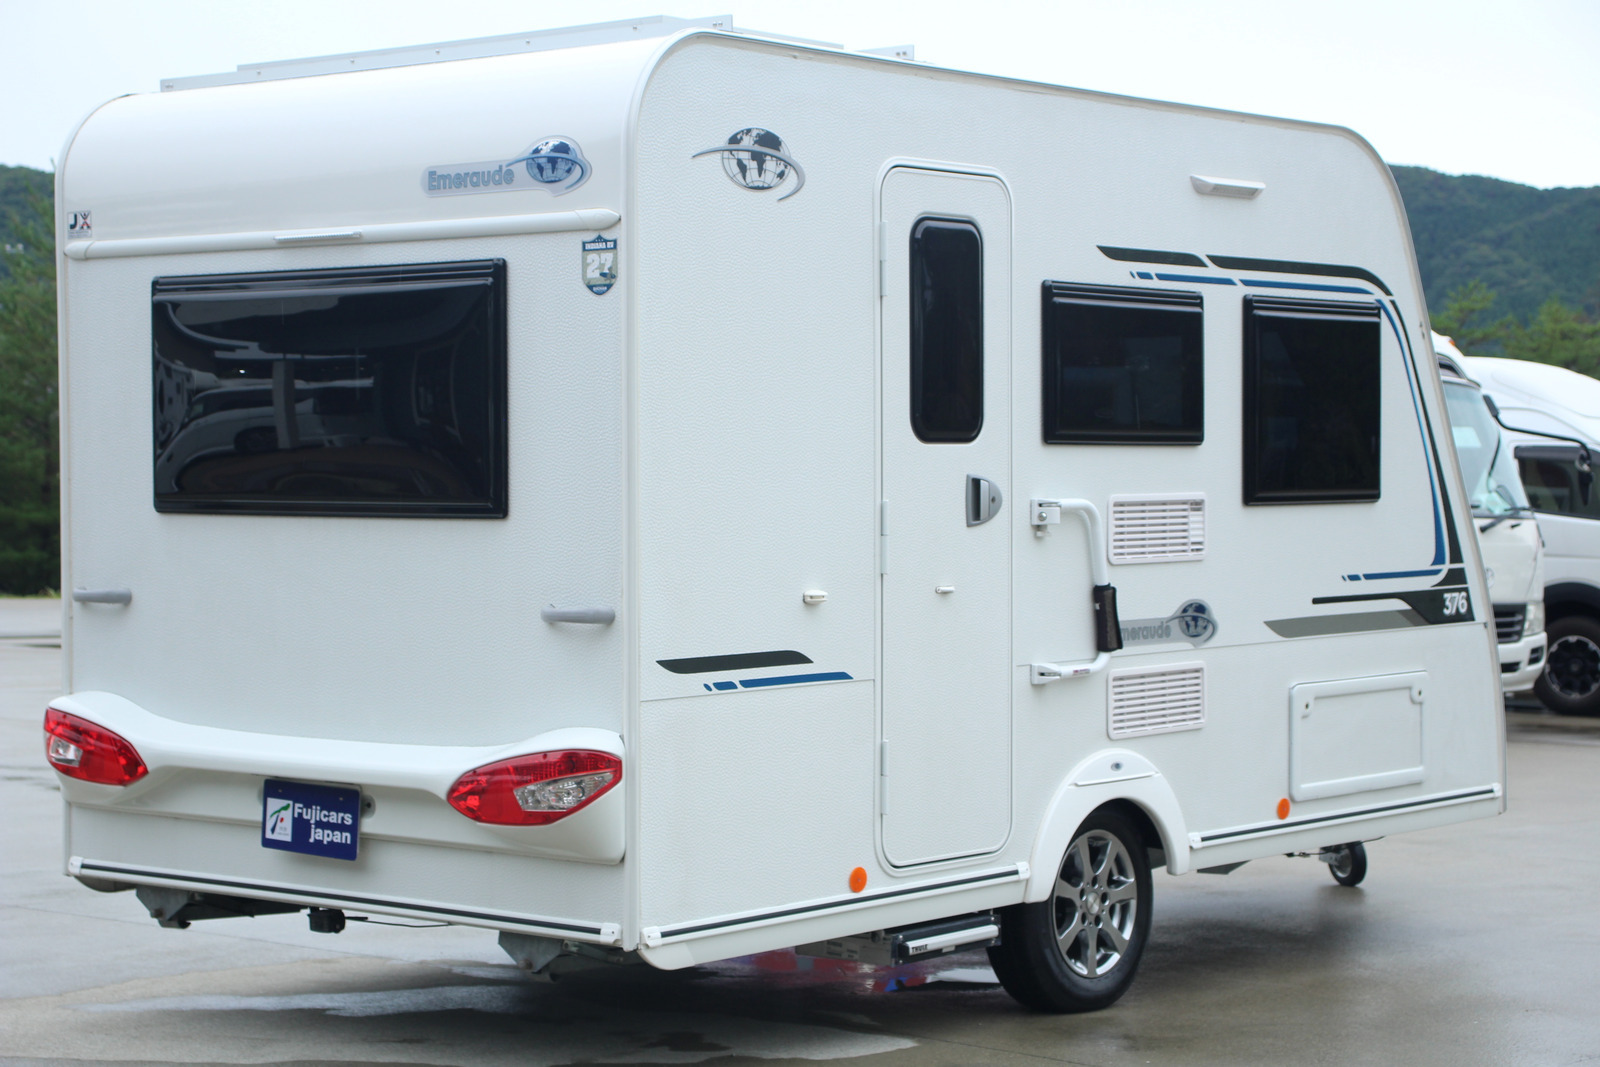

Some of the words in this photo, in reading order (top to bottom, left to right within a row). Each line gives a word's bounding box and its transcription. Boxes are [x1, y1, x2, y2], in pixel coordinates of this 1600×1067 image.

[428, 164, 515, 191] Emeraude
[586, 252, 614, 279] 27
[1443, 591, 1468, 616] 376
[1119, 621, 1172, 641] meraude
[294, 803, 353, 825] Fujicars
[309, 824, 351, 844] japan
